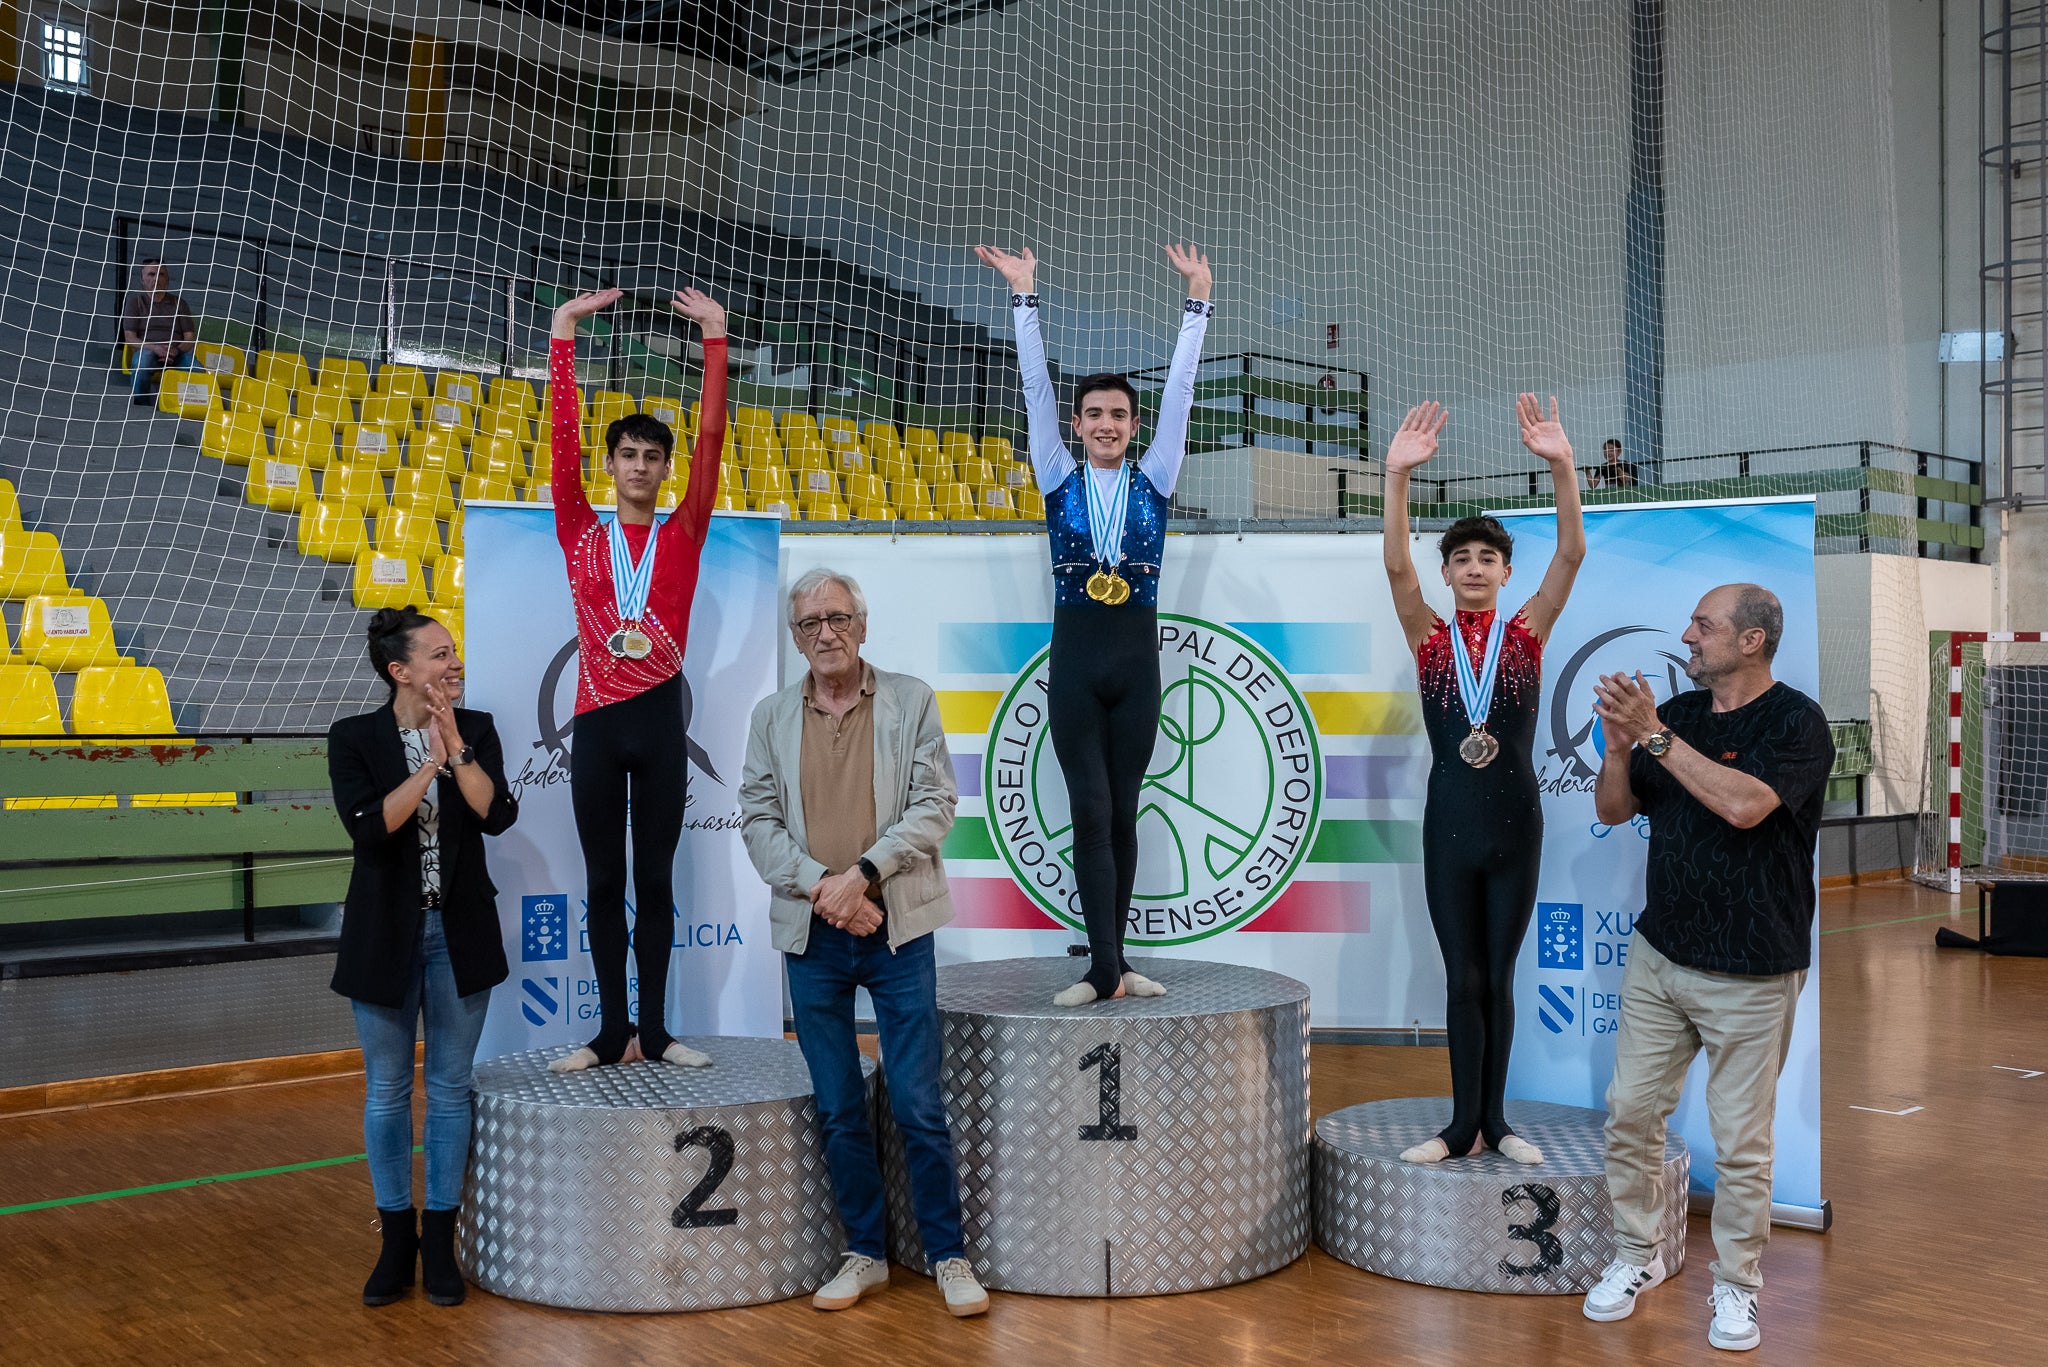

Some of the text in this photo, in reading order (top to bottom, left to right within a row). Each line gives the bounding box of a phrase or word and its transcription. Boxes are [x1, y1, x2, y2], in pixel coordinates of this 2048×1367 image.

[1225, 652, 1275, 702] DE
[998, 702, 1062, 888] CONSELLO
[1245, 701, 1311, 892] DEPORTES
[1067, 887, 1242, 935] ORENSE
[1079, 1042, 1138, 1141] 1
[672, 1125, 739, 1229] 2
[1499, 1183, 1564, 1279] 3
